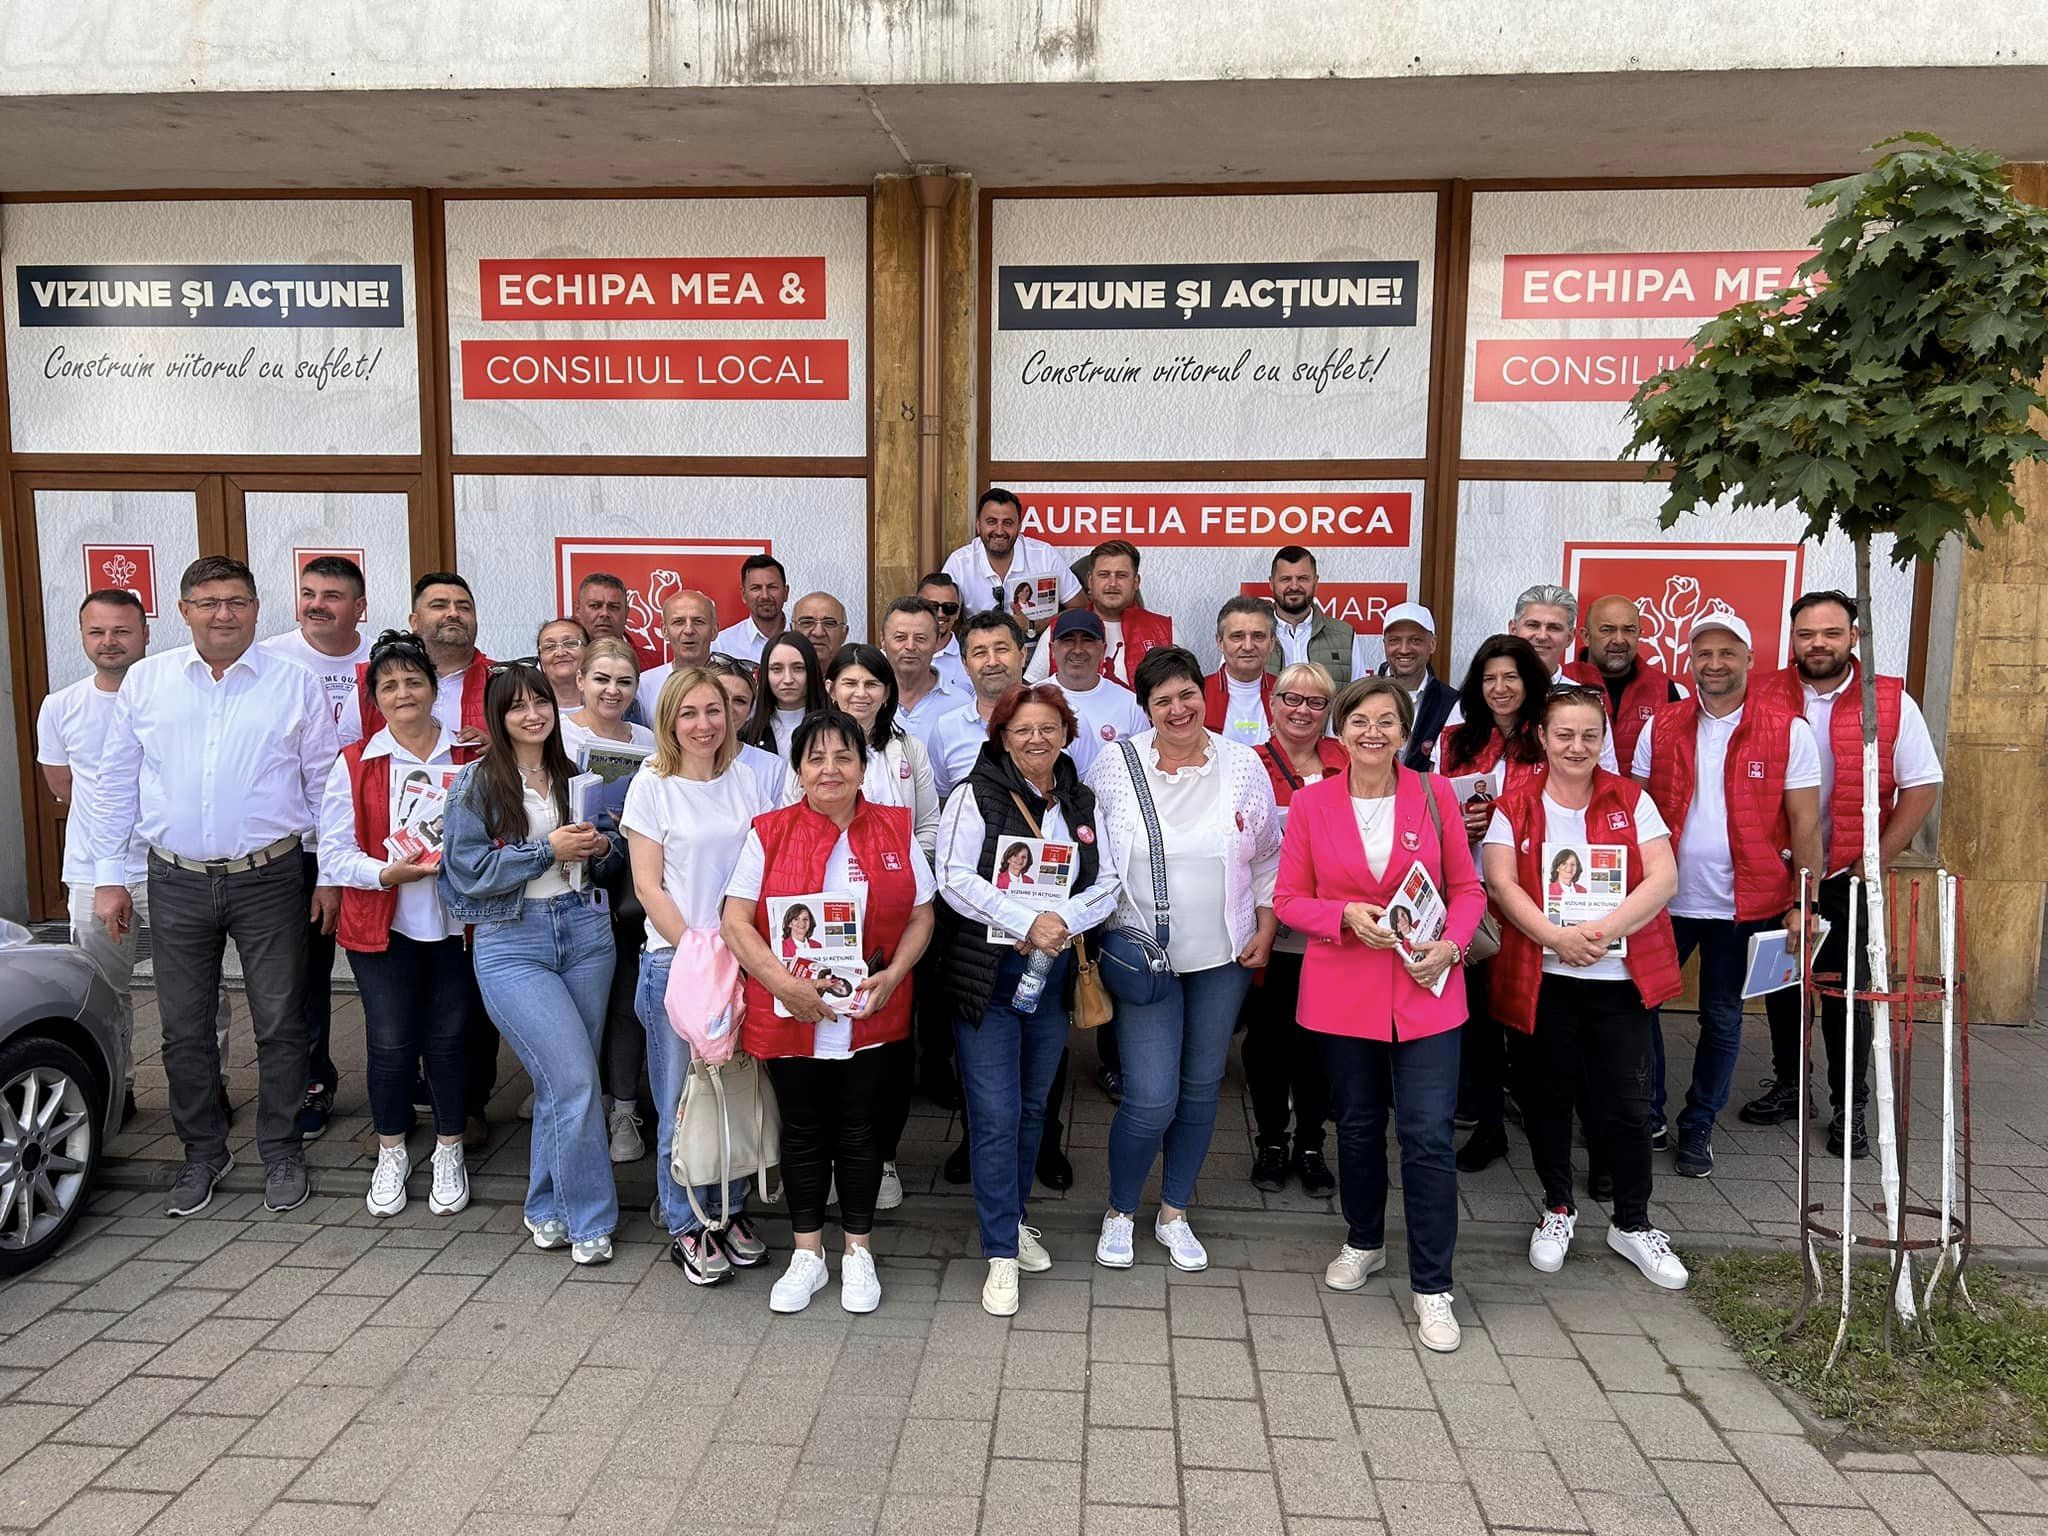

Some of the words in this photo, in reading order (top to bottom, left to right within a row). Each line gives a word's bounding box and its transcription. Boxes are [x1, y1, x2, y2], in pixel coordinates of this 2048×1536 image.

[30, 280, 173, 308] VIZIUNE
[180, 279, 214, 319] ȘI
[223, 280, 390, 319] ACȚIUNE!
[498, 273, 656, 307] ECHIPA
[670, 272, 765, 306] MEA
[777, 271, 807, 305] &
[1013, 279, 1166, 310] VIZIUNE
[1174, 278, 1211, 320] ȘI
[1220, 277, 1403, 319] ACȚIUNE!
[1522, 267, 1696, 303] ECHIPA
[43, 345, 155, 380] Construim
[166, 346, 256, 379] viitorul
[258, 359, 285, 379] cu
[293, 346, 383, 392] suflet!
[485, 354, 684, 385] CONSILIUL
[696, 354, 824, 385] LOCAL
[1020, 348, 1142, 386] Construim
[1151, 347, 1252, 383] viitorul
[1252, 363, 1281, 383] cu
[1291, 346, 1391, 394] suflet!
[1019, 505, 1187, 534] AURELIA
[1199, 504, 1394, 535] FEDORCA
